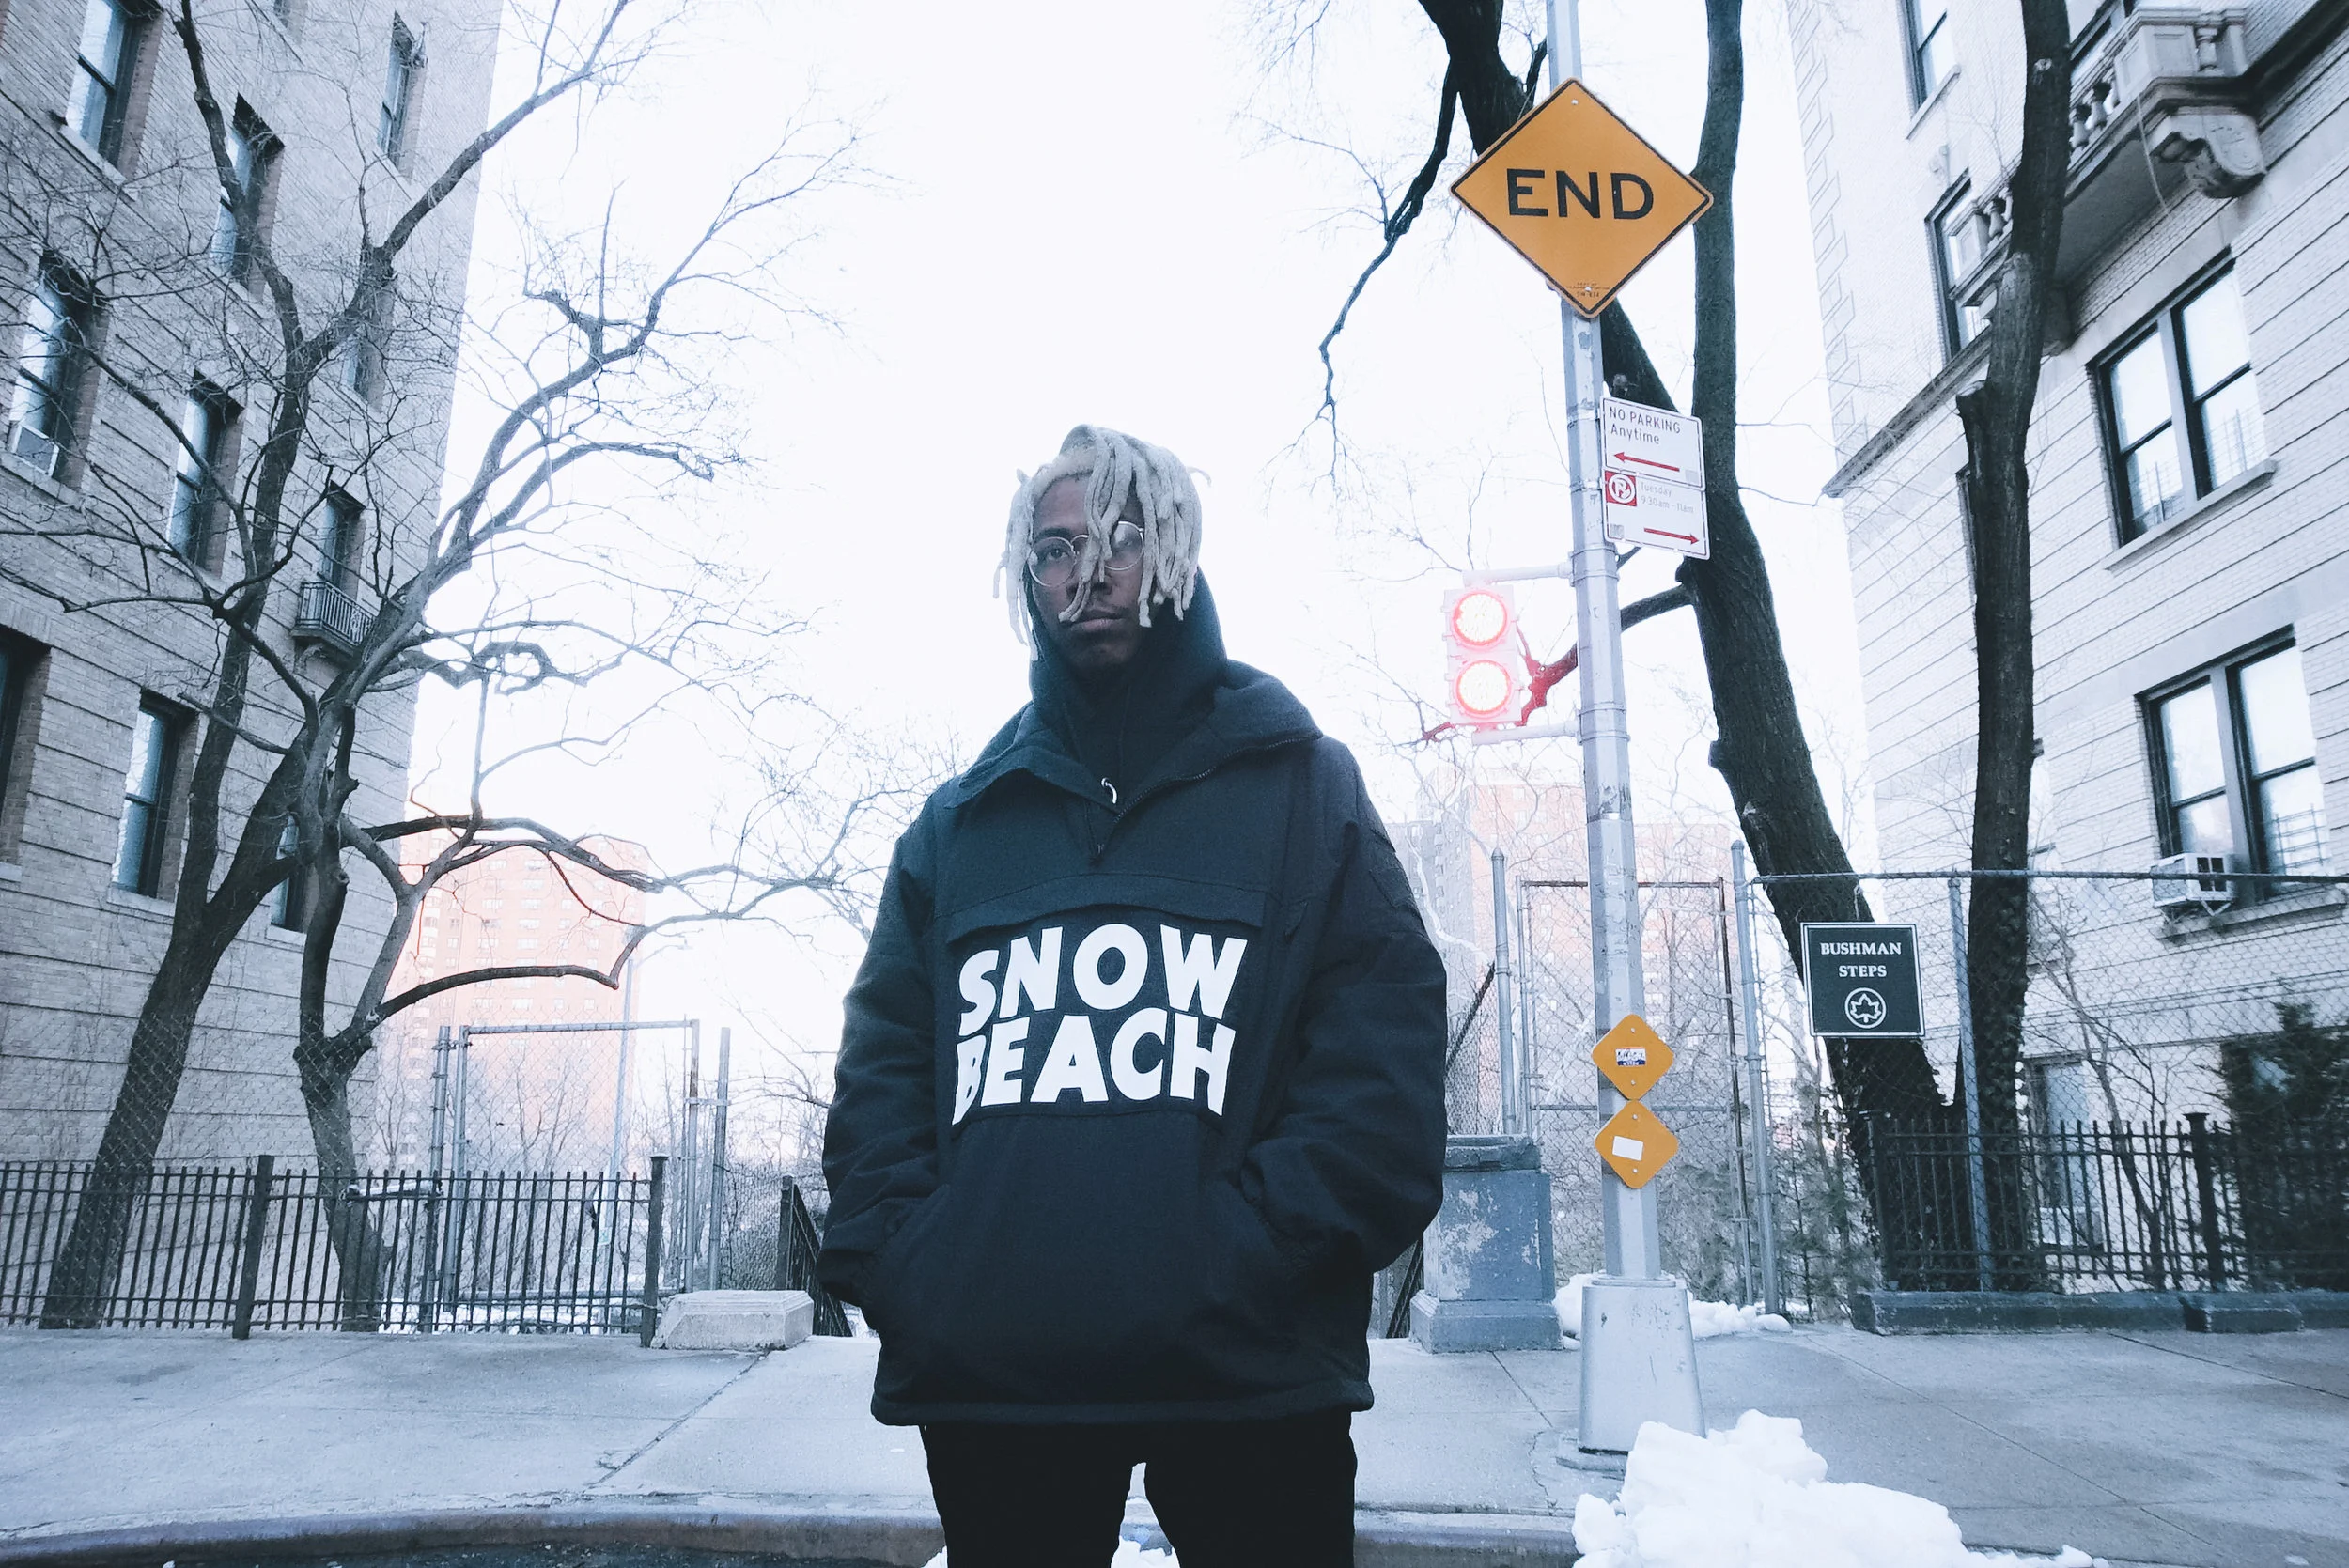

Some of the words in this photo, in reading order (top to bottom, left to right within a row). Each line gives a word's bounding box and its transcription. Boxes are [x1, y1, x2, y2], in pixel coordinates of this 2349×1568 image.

[1506, 168, 1654, 220] END
[1610, 407, 1626, 421] NO
[1630, 412, 1681, 434] PARKING
[1610, 424, 1660, 445] Anytime
[1641, 482, 1672, 498] Tuesday
[1641, 495, 1670, 509] 930am
[1820, 942, 1902, 955] BUSHMAN
[958, 923, 1248, 1037] SNOW
[1838, 965, 1887, 977] STEPS
[952, 1007, 1237, 1126] BEACH
